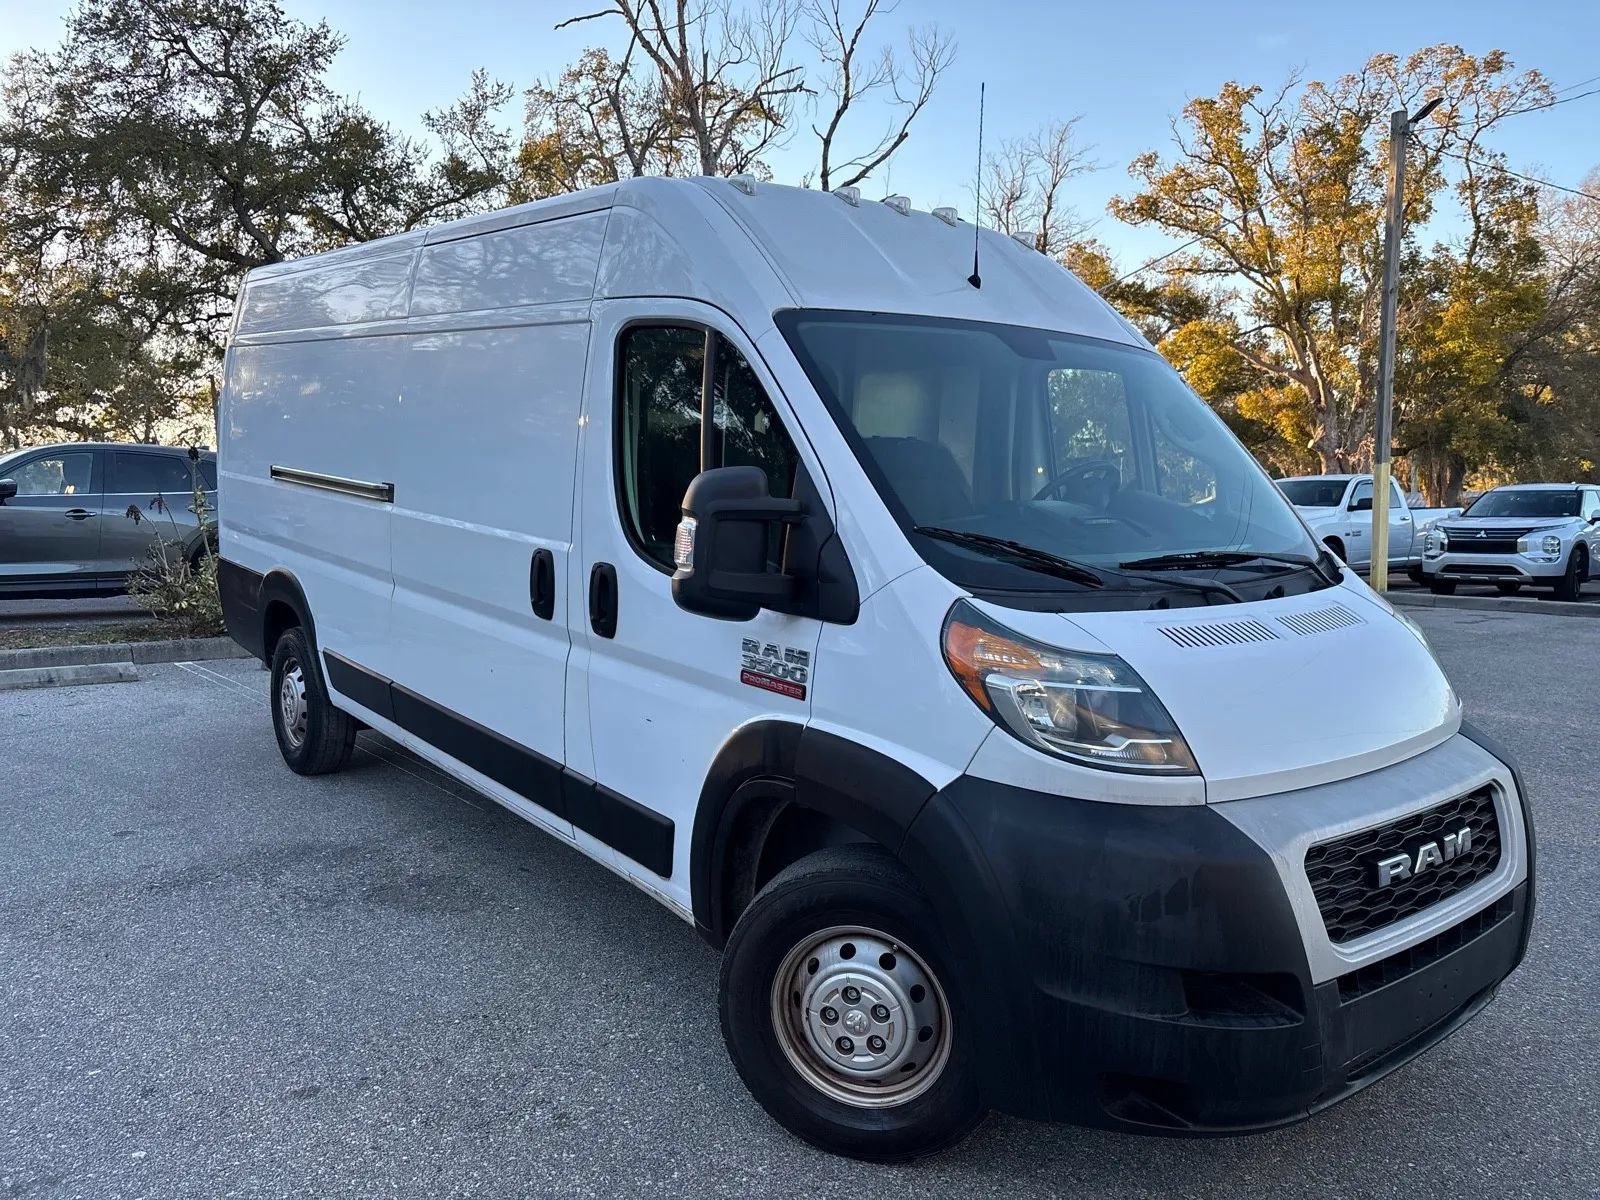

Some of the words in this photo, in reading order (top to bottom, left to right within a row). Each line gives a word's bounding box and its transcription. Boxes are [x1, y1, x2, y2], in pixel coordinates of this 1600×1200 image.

[742, 637, 810, 667] RAM
[741, 654, 808, 683] 3500
[1377, 826, 1472, 888] RAM
